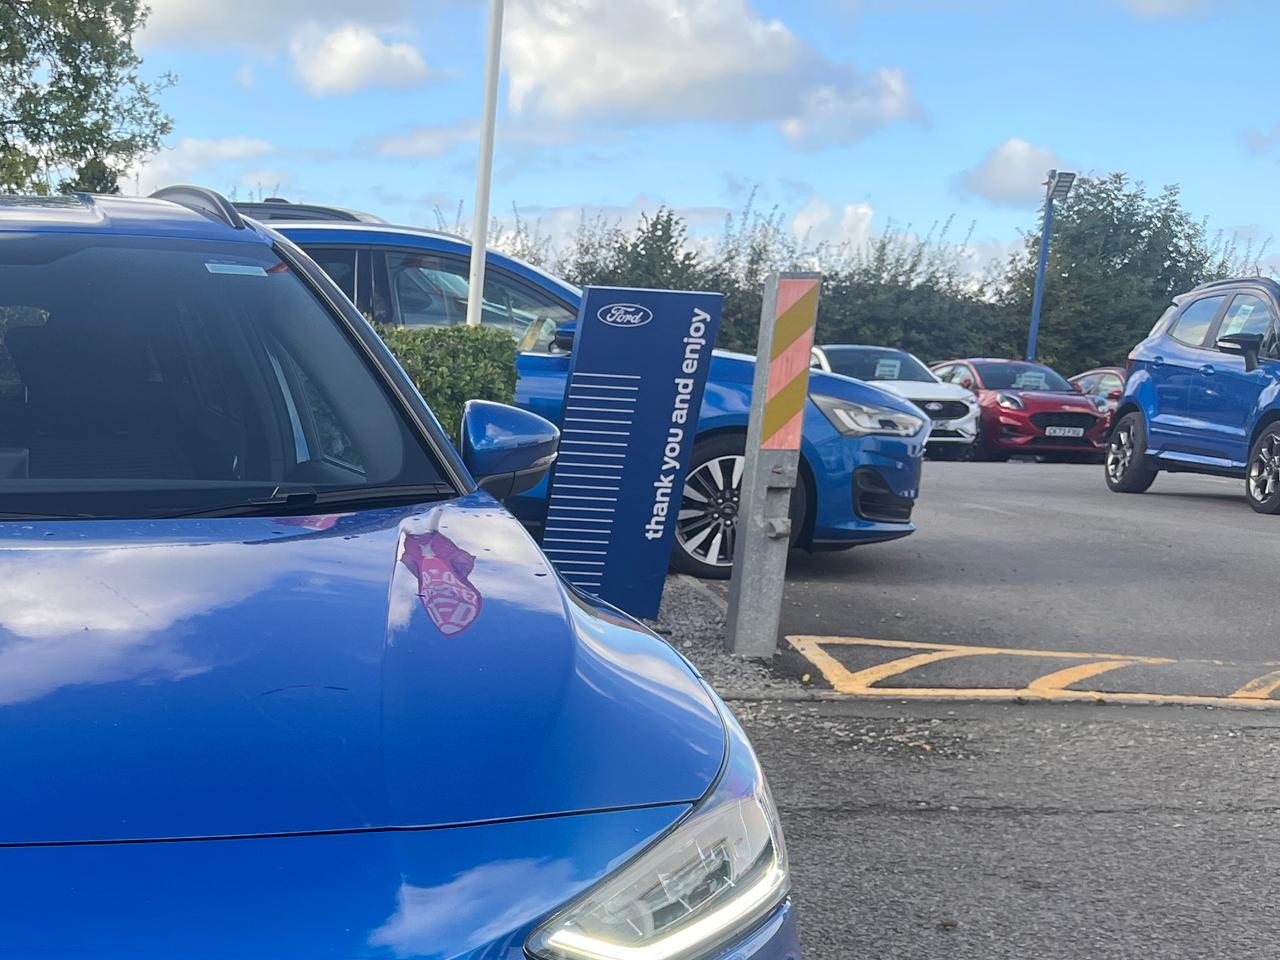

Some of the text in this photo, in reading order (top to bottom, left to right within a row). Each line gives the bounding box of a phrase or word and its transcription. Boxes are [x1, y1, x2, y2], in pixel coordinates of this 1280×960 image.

[606, 306, 644, 323] Ford
[645, 307, 711, 540] thank you and enjoy
